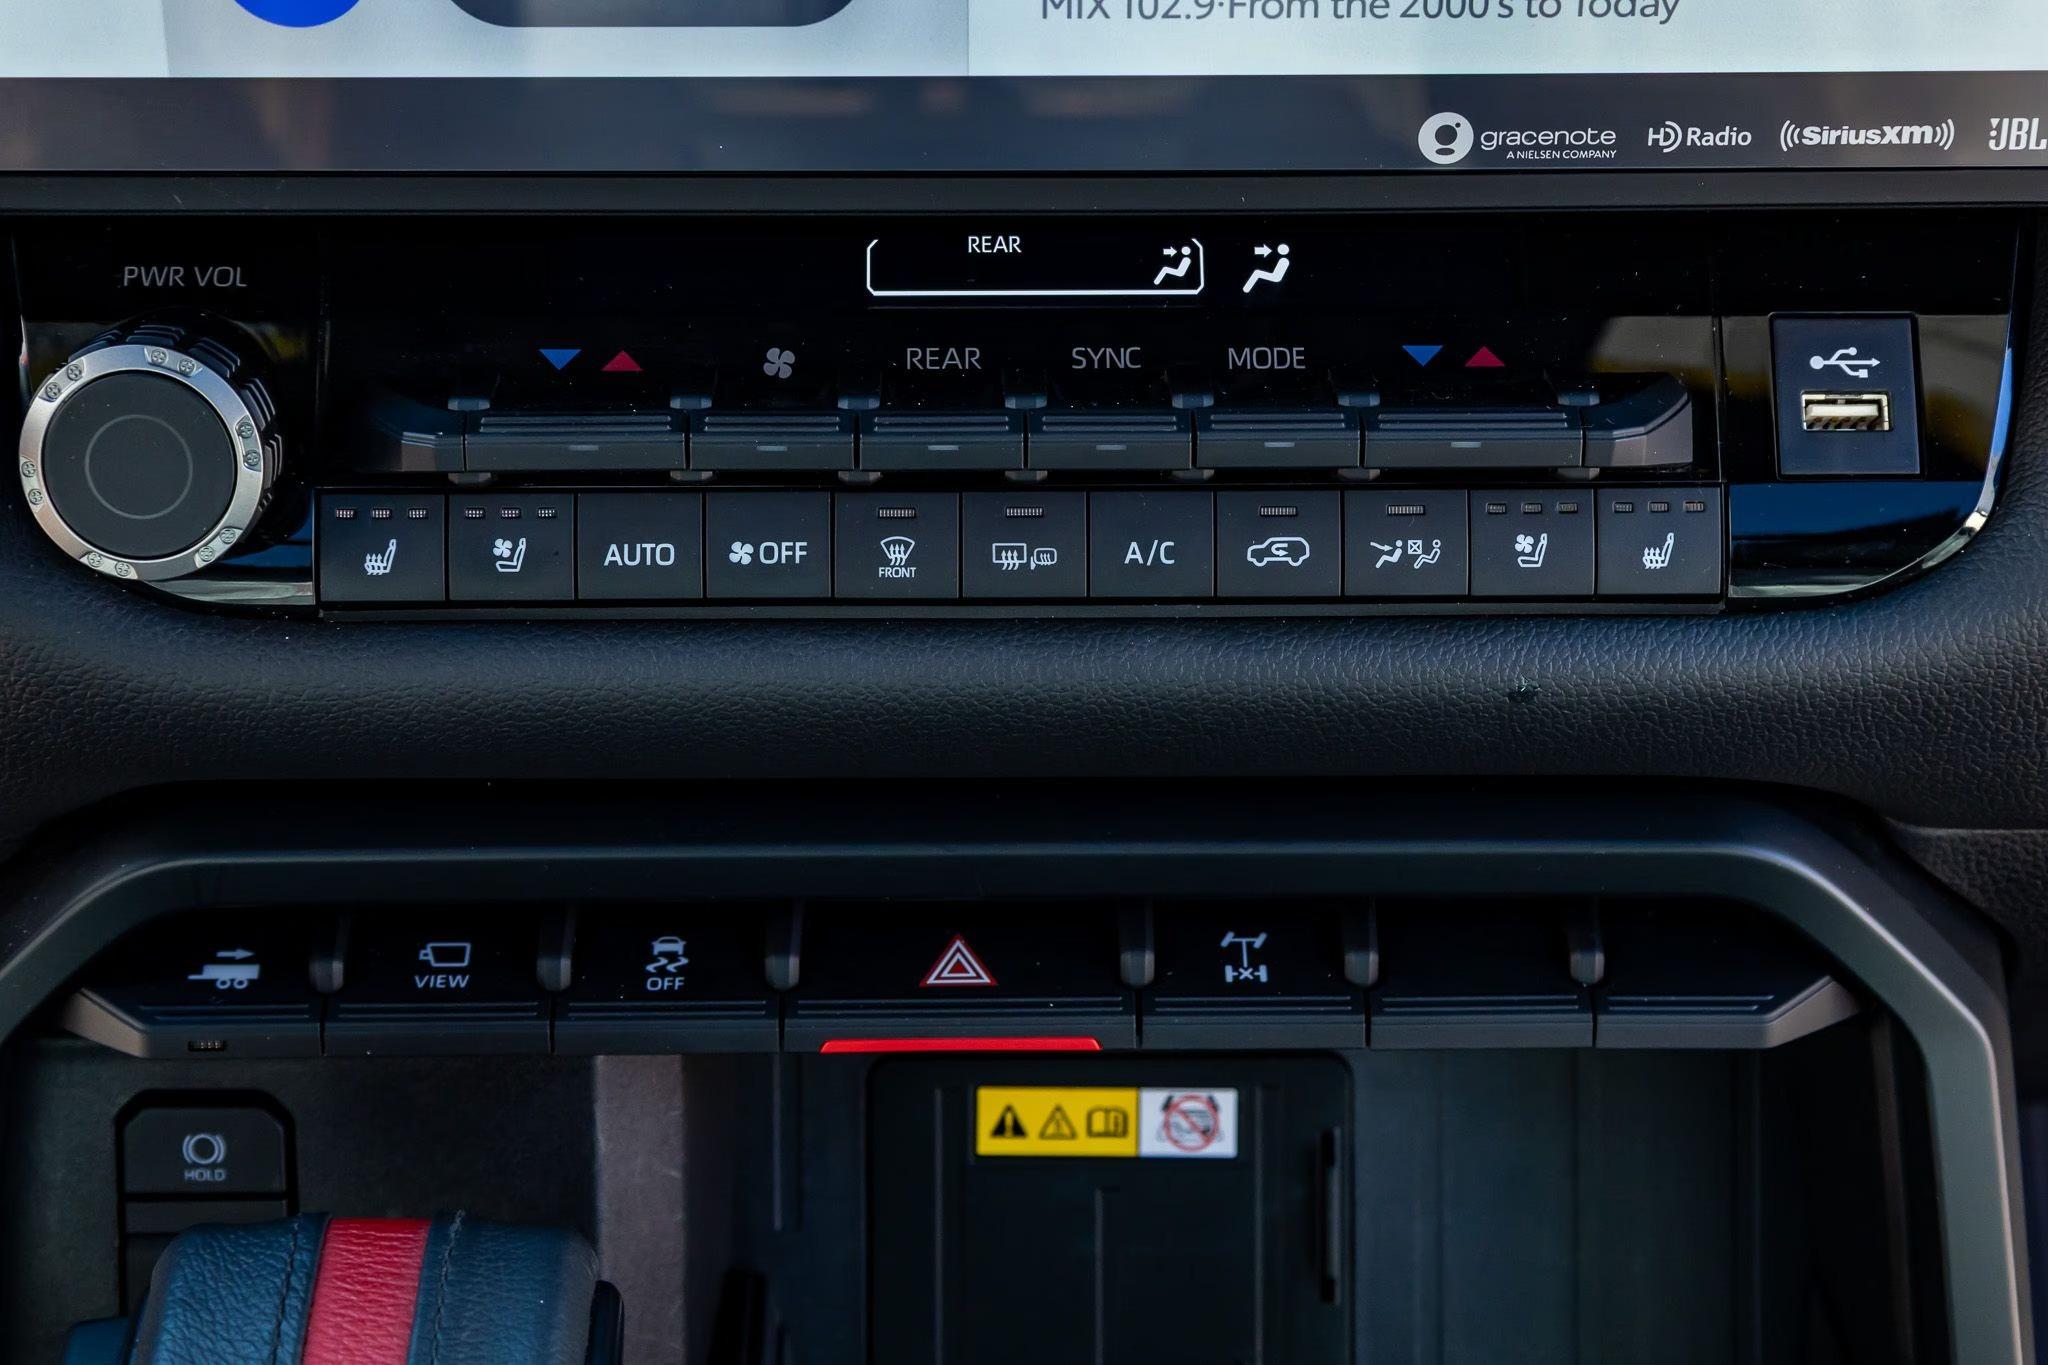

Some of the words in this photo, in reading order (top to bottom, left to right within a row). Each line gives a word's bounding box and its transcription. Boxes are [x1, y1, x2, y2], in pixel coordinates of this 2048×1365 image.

[1329, 0, 1390, 19] the
[1399, 0, 1514, 19] 2000s
[1526, 0, 1562, 19] to
[1480, 127, 1617, 151] gracenote
[1686, 125, 1752, 147] Radio
[1988, 117, 2048, 151] JBL
[1506, 150, 1515, 159] A
[1516, 149, 1561, 160] NIELSEN
[1562, 149, 1617, 159] COMPANY
[967, 235, 1022, 253] REAR
[123, 266, 185, 287] PWR
[194, 266, 247, 288] VOL
[906, 347, 982, 370] REAR
[1071, 346, 1142, 369] SYNC
[1228, 346, 1306, 370] MODE
[603, 543, 676, 566] AUTO
[758, 541, 808, 565] OFF
[1124, 540, 1175, 566] A/C
[878, 566, 917, 578] FRONT
[414, 974, 470, 989] VIEW
[646, 976, 685, 991] OFF
[184, 1168, 226, 1182] HOLD
